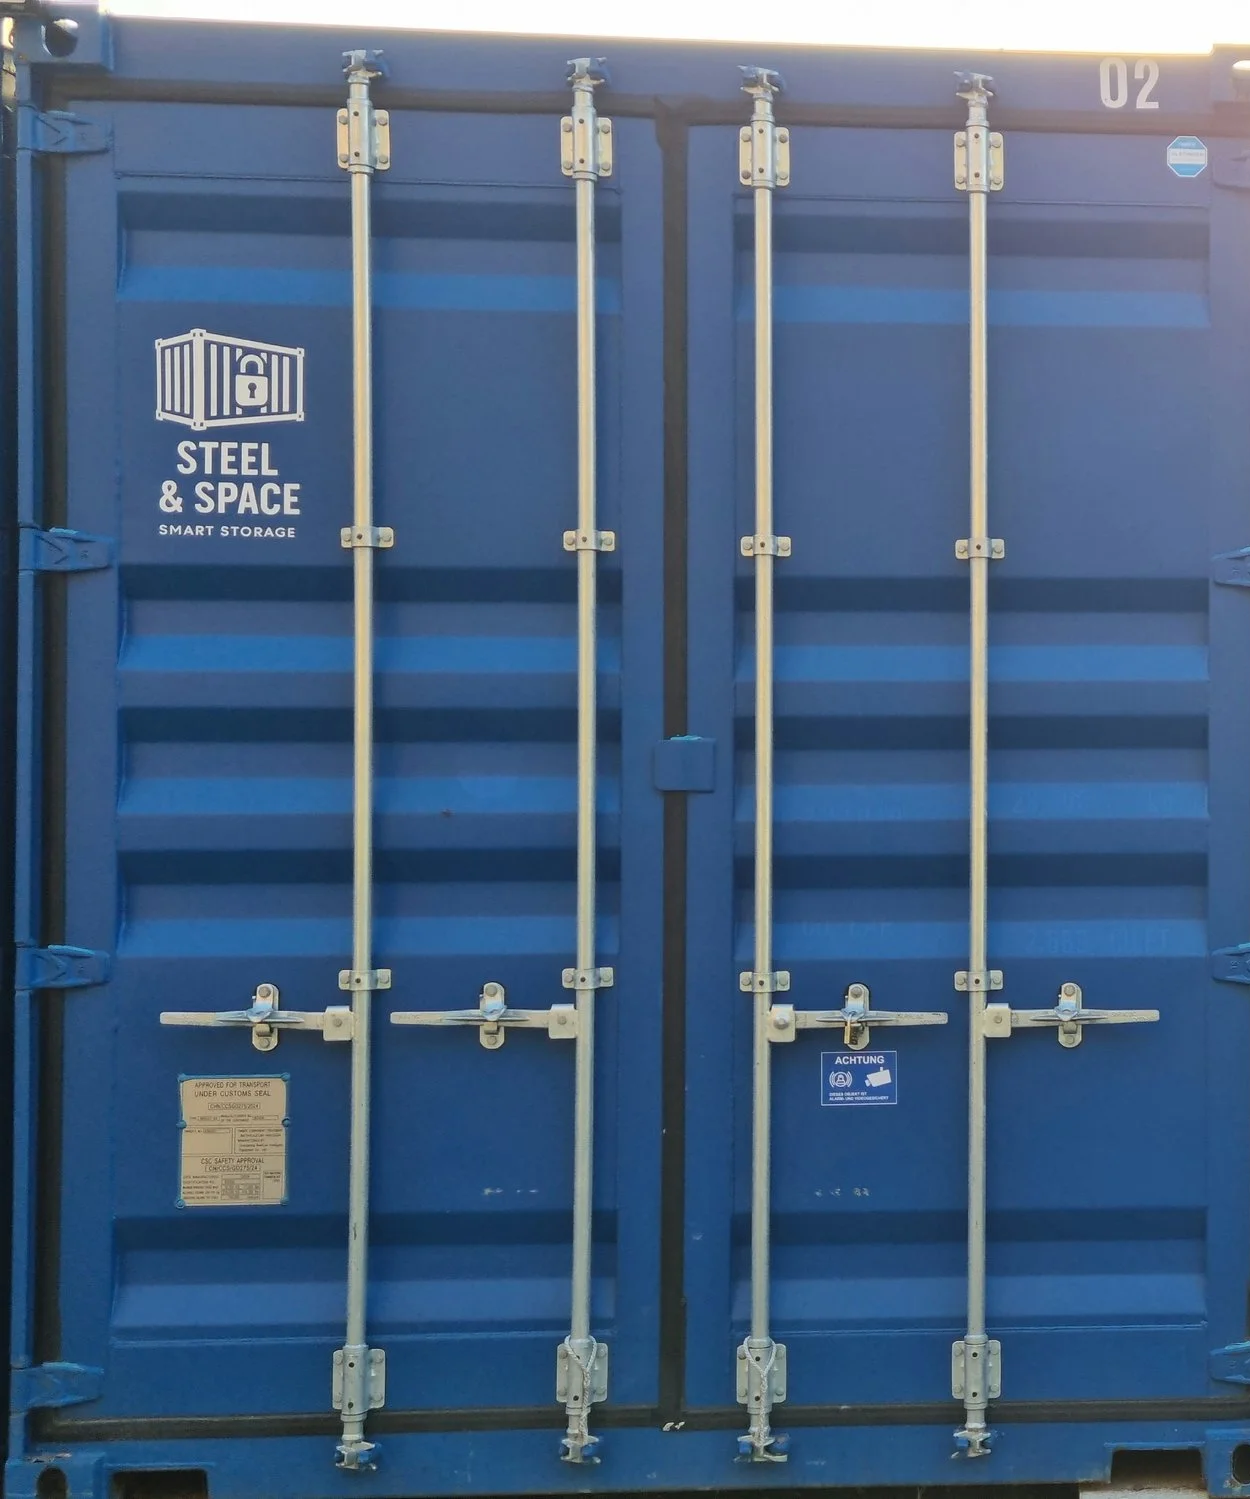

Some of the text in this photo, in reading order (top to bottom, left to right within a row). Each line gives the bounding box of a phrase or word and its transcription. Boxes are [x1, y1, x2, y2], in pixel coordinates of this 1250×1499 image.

[1100, 57, 1159, 109] 02
[176, 440, 279, 476] STEEL
[159, 479, 301, 515] & SPACE
[159, 524, 296, 538] SMART STORAGE
[834, 1055, 885, 1065] ACHTUNG
[194, 1081, 224, 1089] APPROVED
[194, 1090, 217, 1098] UNDER
[200, 1157, 212, 1165] CSC
[214, 1157, 235, 1165] SAFETY
